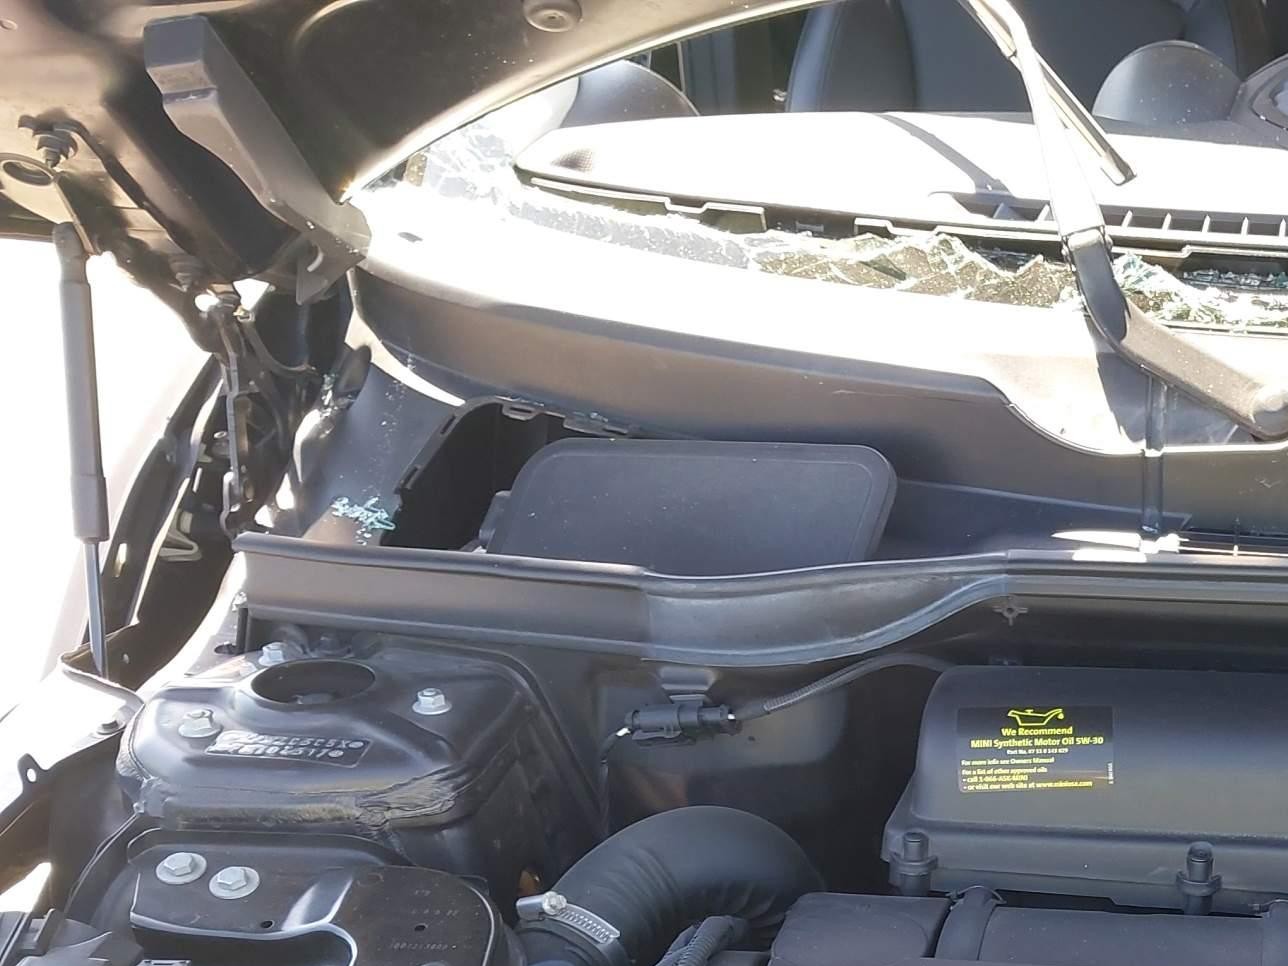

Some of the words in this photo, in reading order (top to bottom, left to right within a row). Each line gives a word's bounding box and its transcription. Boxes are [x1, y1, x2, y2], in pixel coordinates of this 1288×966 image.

[1001, 728, 1017, 736] We
[1018, 726, 1073, 736] Recommend
[970, 739, 993, 748] MINI
[993, 738, 1033, 749] Synthetic
[1034, 738, 1061, 746] Motor
[1061, 736, 1075, 745] Oil
[1075, 736, 1104, 745] 5W-30
